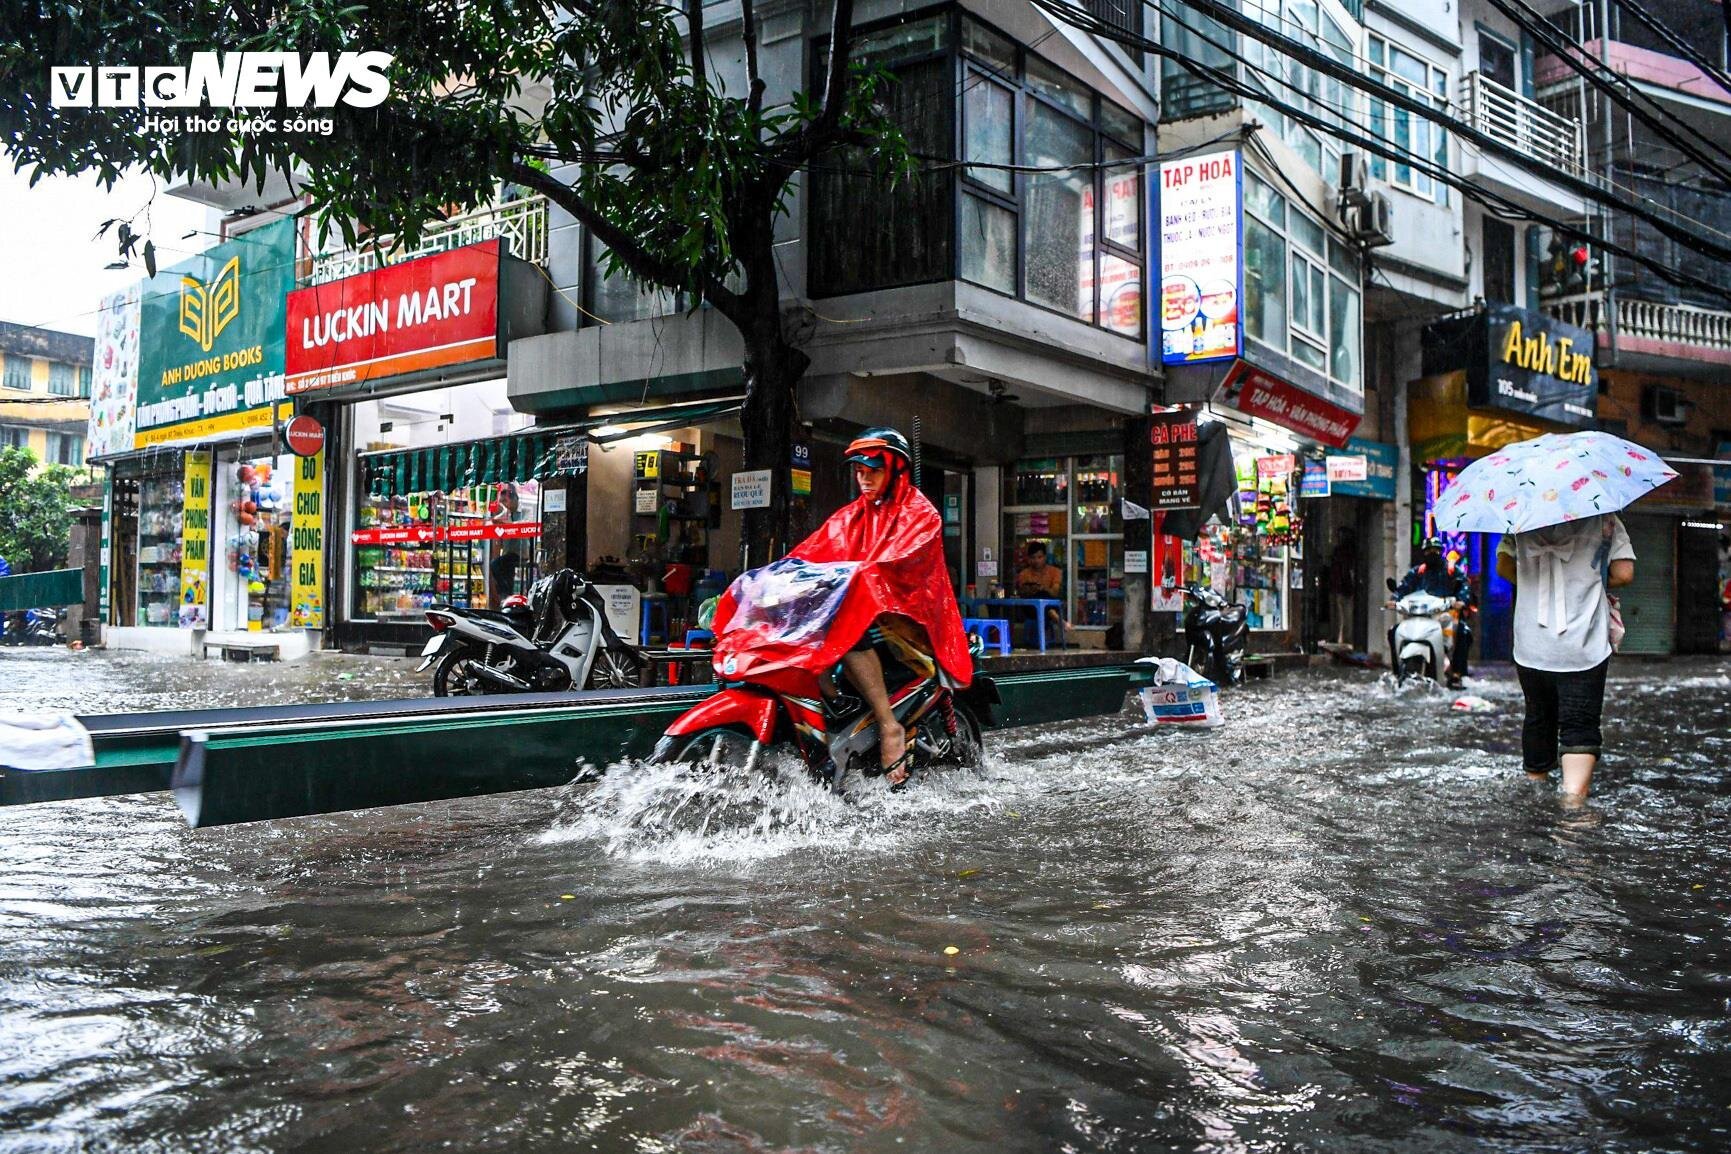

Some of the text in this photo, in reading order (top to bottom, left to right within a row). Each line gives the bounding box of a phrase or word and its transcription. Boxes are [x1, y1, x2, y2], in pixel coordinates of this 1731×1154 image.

[302, 277, 477, 350] LUCKIN MART
[223, 344, 263, 372] BOOKS
[1504, 320, 1592, 385] Anh Em
[795, 445, 809, 458] 99
[191, 476, 205, 498] VĂN
[185, 505, 208, 529] PHÒNG
[296, 492, 320, 516] CHƠI
[294, 520, 321, 551] ĐỒNG
[299, 558, 316, 586] GIÁ
